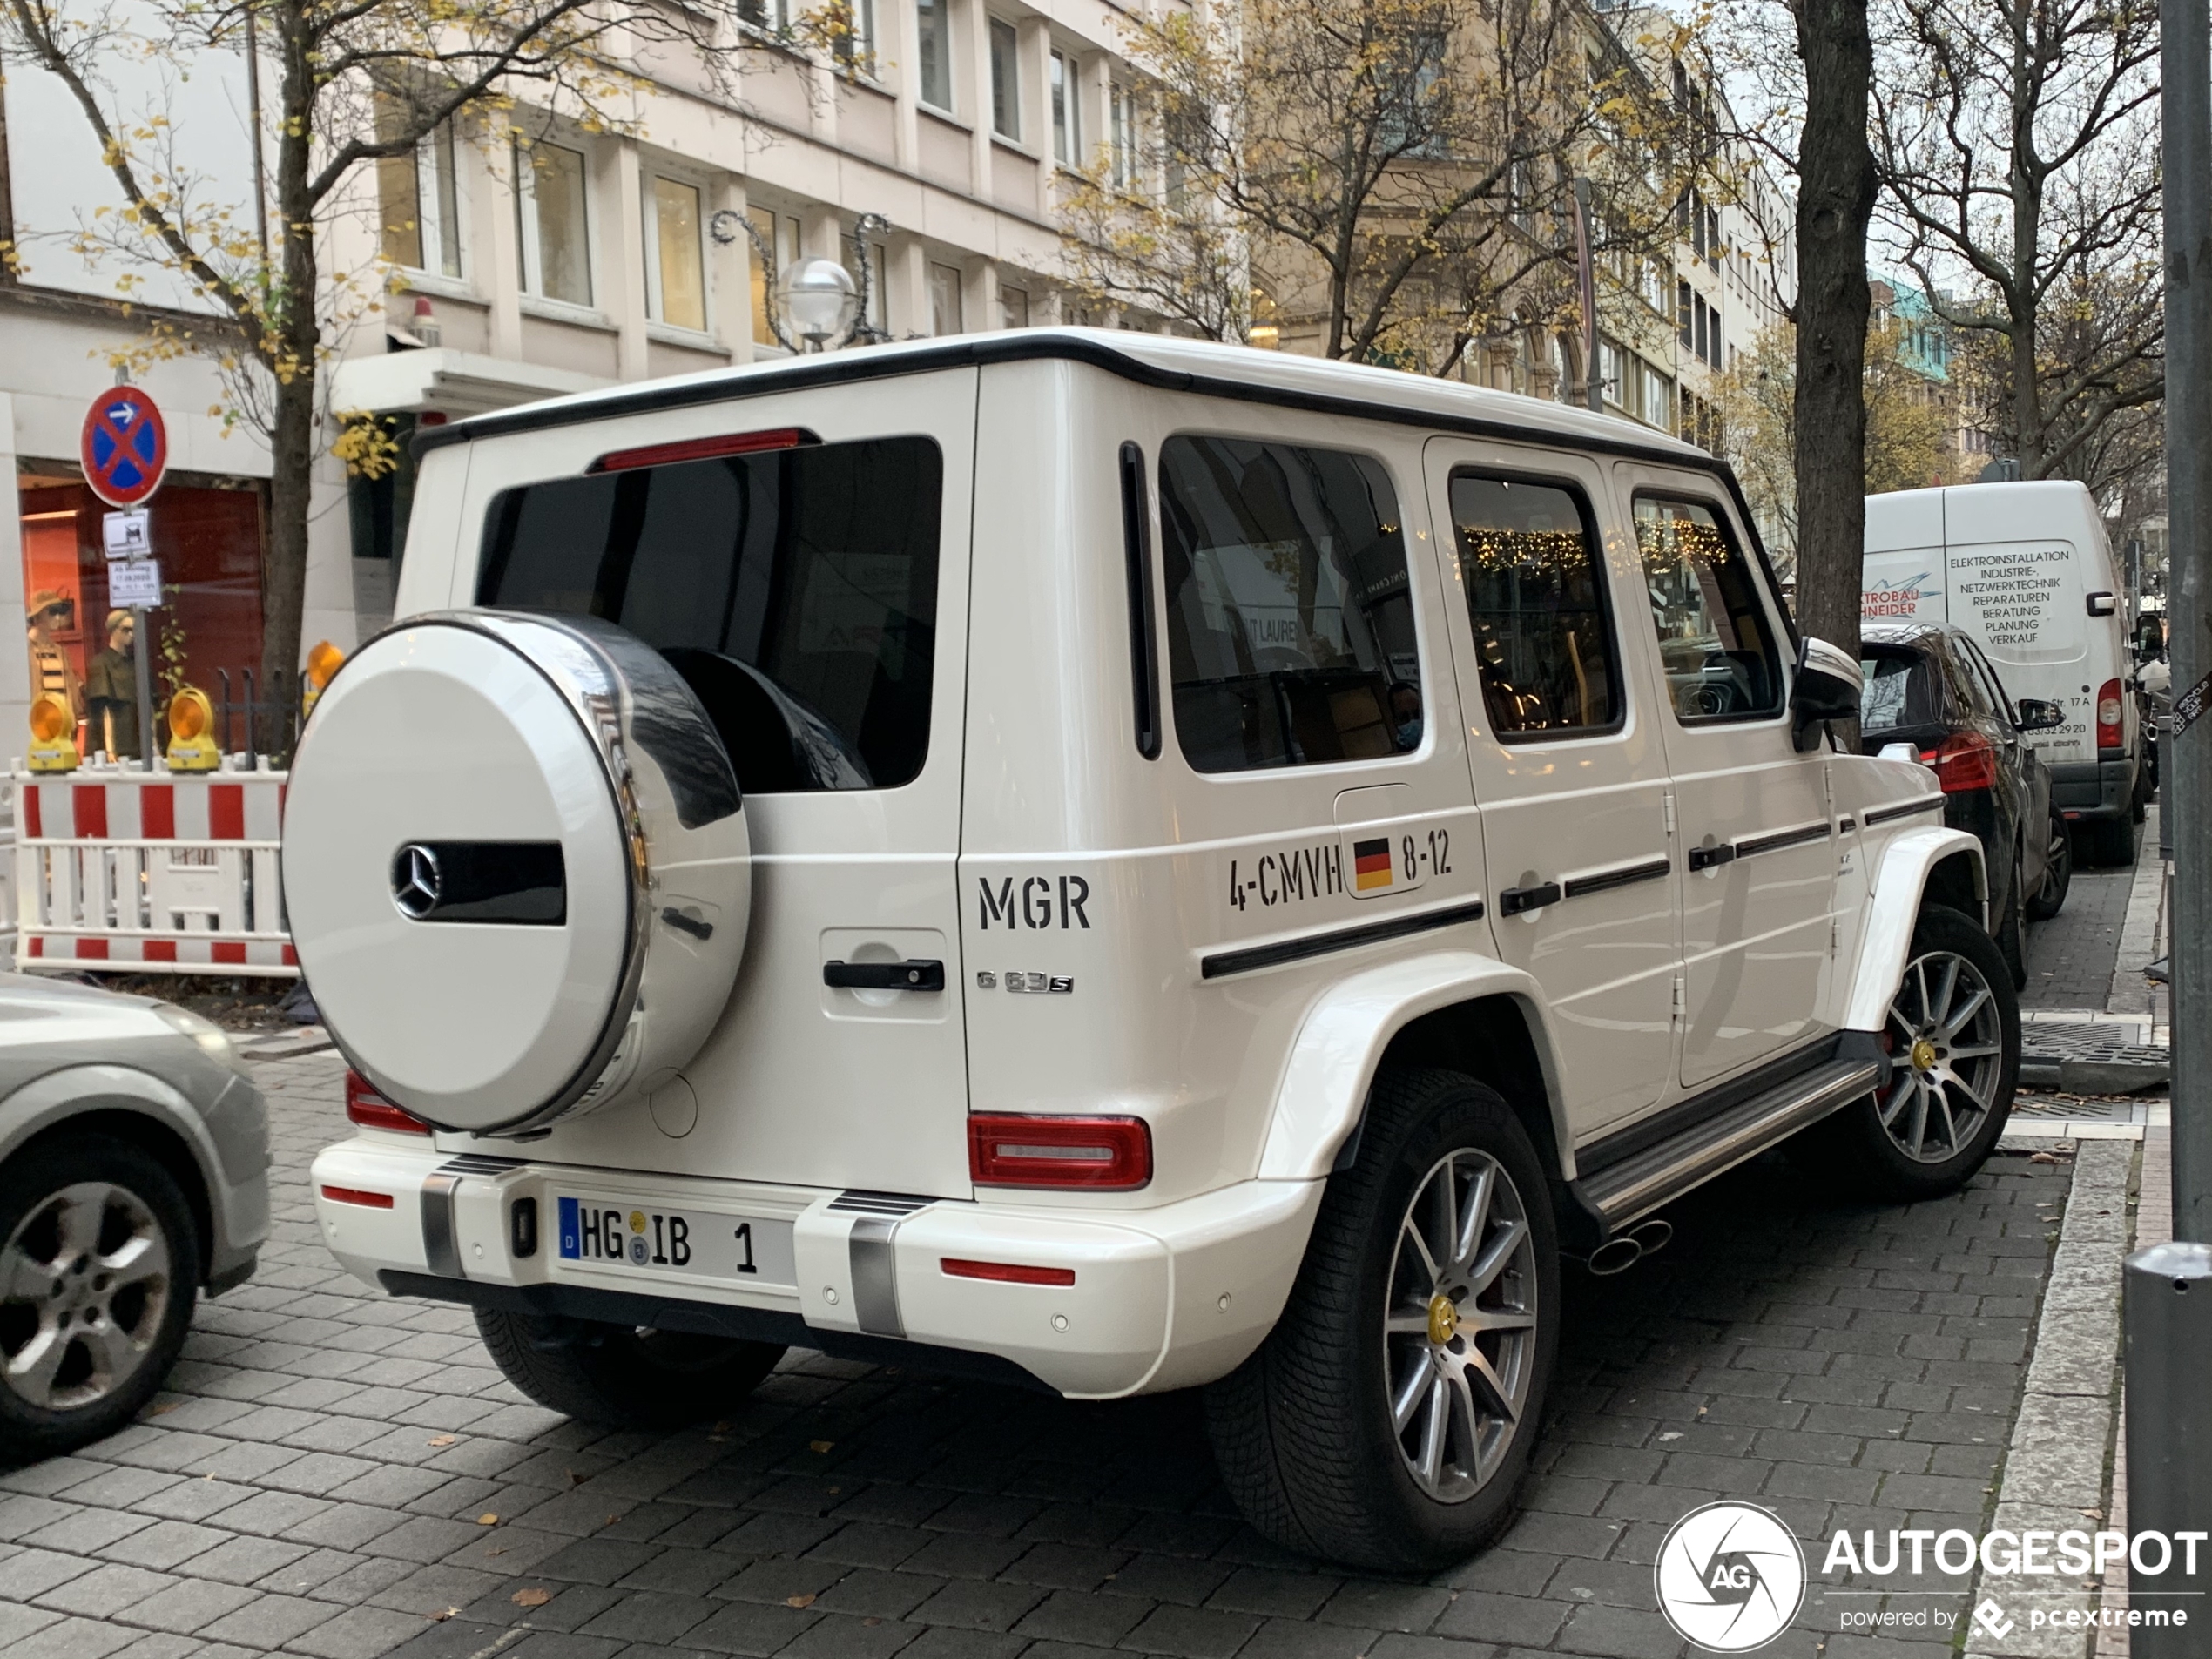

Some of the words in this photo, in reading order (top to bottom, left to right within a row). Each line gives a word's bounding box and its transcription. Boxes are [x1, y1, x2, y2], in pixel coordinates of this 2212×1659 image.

[1951, 551, 2069, 568] ELEKTROINSTALLATION
[1960, 578, 2060, 593] NETZWERKTECHNIK
[1973, 592, 2050, 606] REPARATUREN
[1983, 606, 2041, 619] BERATUNG
[1986, 619, 2039, 632] PLANUNG
[1988, 632, 2038, 644] VERKAUF
[2070, 698, 2080, 706] 17
[2082, 697, 2091, 706] A
[2059, 725, 2072, 734] 29
[2073, 724, 2087, 733] 20
[1230, 844, 1343, 911] 4-CMVH
[1403, 828, 1452, 881] 8-12
[979, 876, 1090, 929] MGR
[565, 1235, 574, 1249] D
[580, 1208, 624, 1259] HG
[652, 1215, 691, 1266] IB
[734, 1223, 757, 1273] 1
